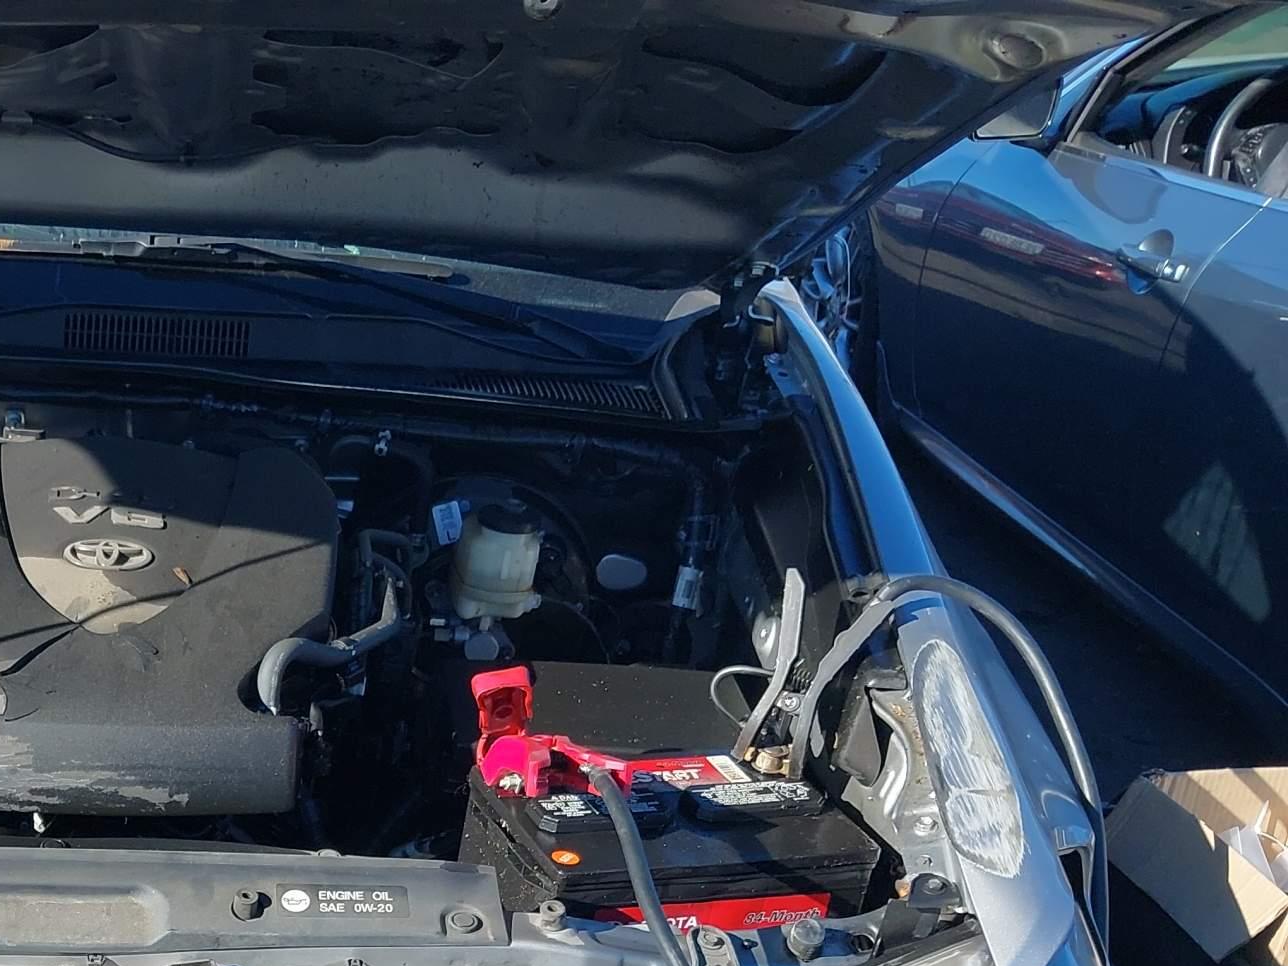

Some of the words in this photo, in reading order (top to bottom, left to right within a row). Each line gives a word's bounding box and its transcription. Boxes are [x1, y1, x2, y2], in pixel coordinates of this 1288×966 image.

[318, 890, 365, 901] ENGINE
[372, 890, 393, 902] OIL
[319, 903, 345, 913] SAE
[354, 903, 394, 914] 0W-20
[743, 908, 821, 926] 84-Month
